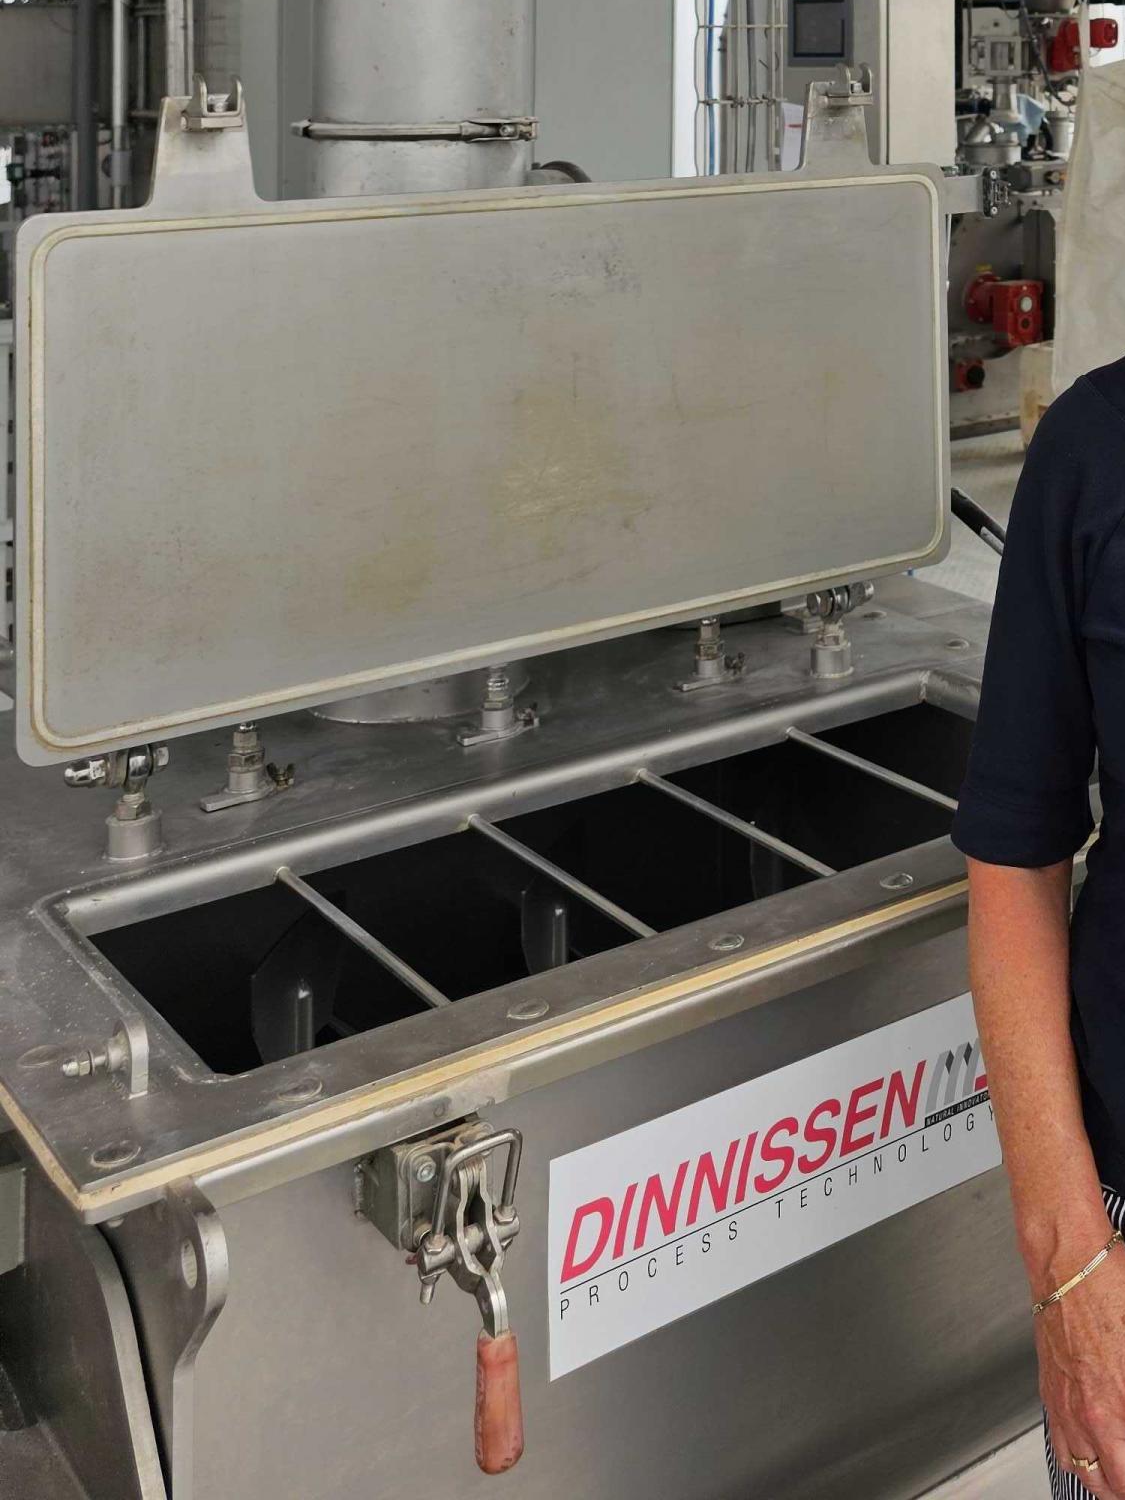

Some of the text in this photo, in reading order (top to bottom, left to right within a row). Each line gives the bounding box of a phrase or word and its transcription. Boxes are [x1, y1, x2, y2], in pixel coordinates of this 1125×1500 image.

[926, 1106, 955, 1127] NATURAL
[560, 1059, 927, 1284] DINNISSEN
[559, 1219, 739, 1321] PROCESS
